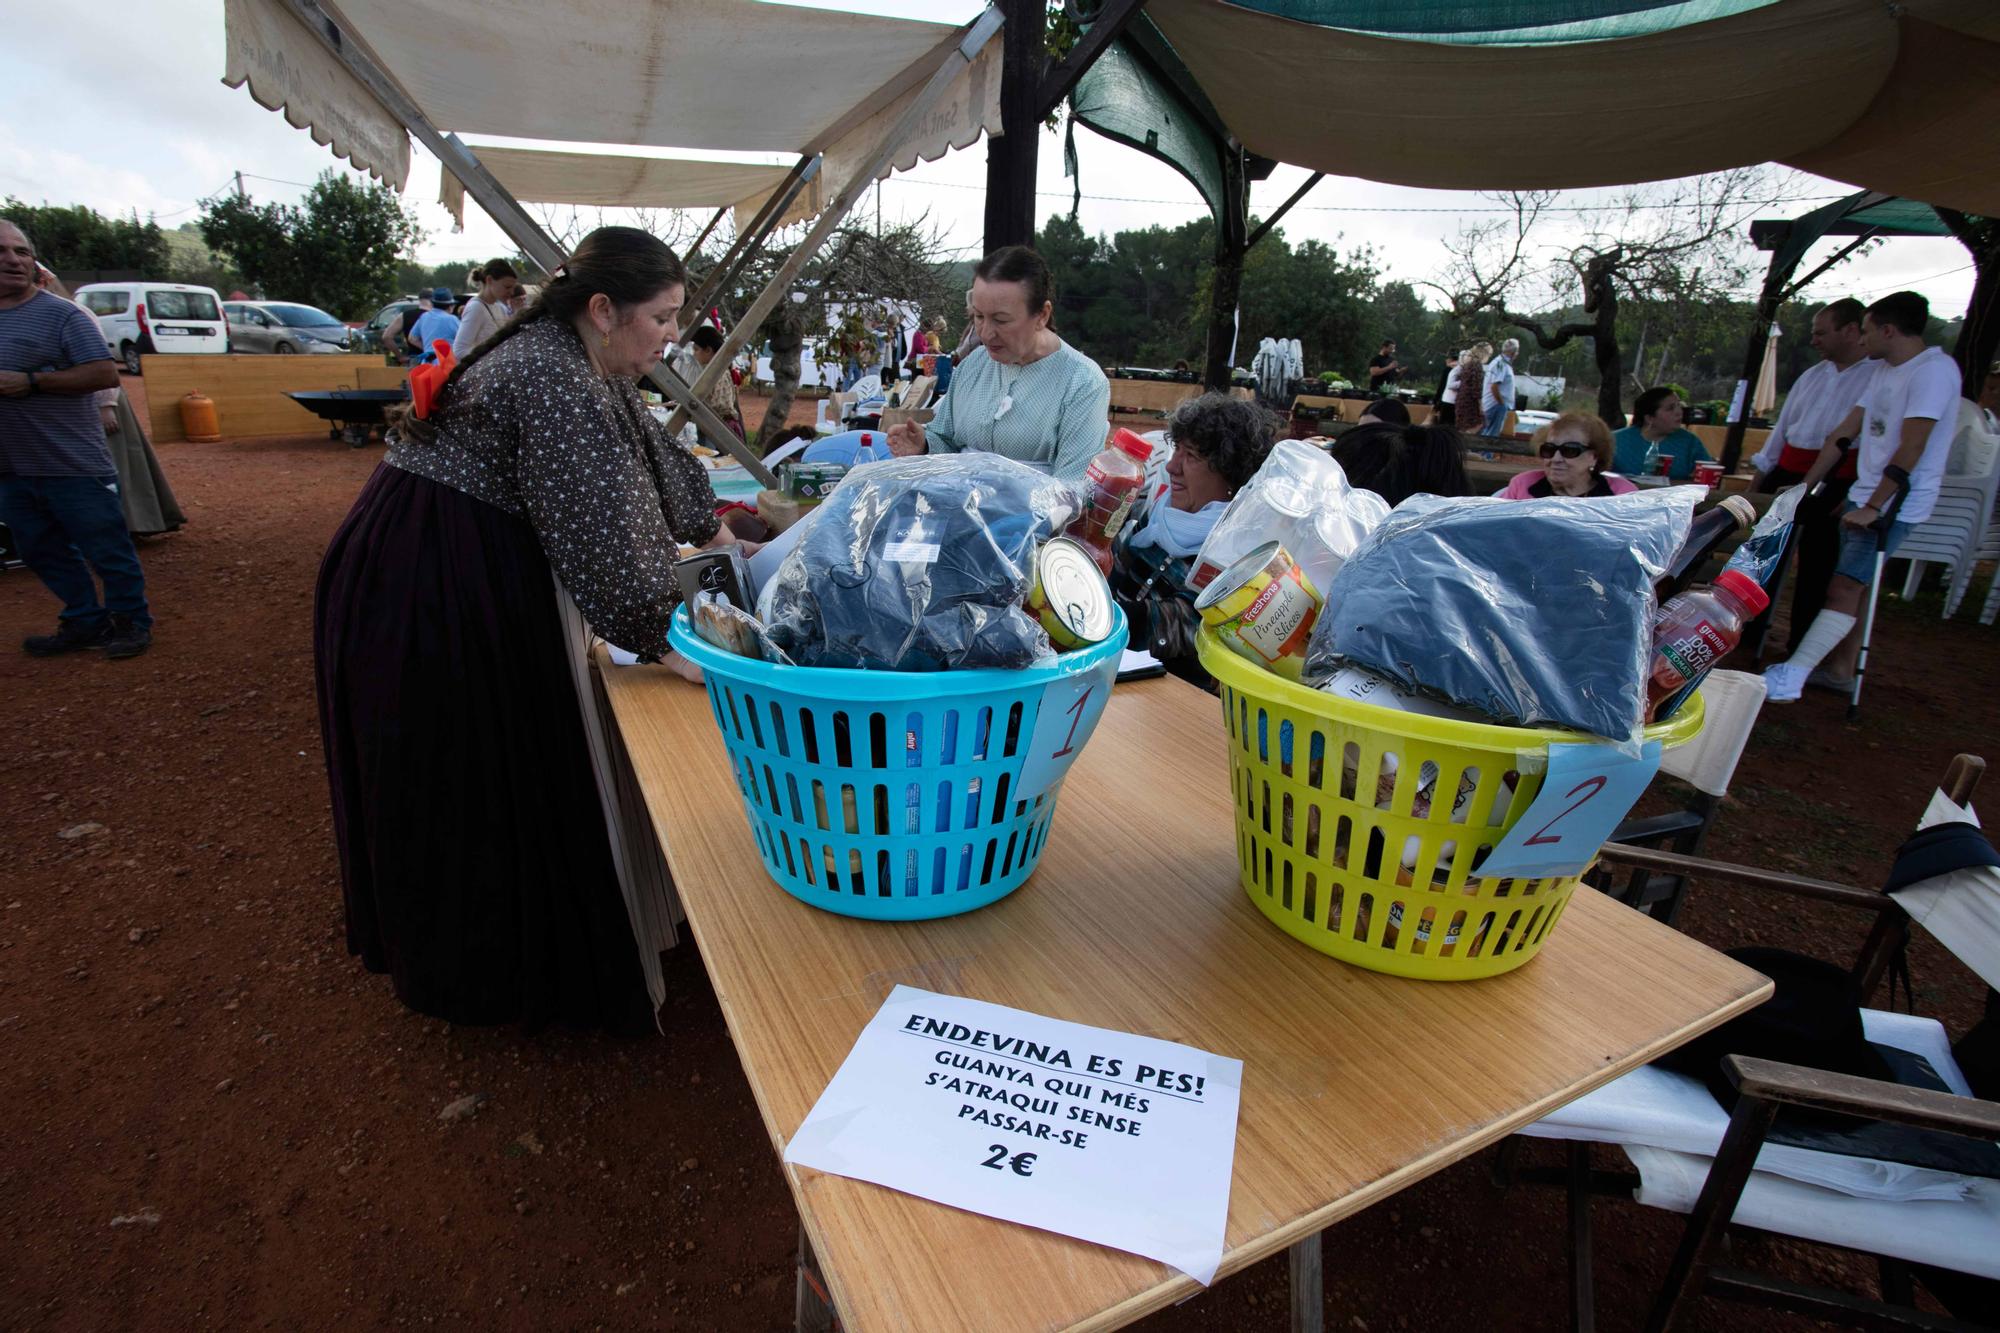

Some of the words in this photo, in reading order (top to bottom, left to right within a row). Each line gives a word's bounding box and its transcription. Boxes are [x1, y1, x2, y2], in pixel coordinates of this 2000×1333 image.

[1244, 583, 1279, 622] Freshona
[1252, 590, 1296, 640] Pineapple
[1273, 611, 1302, 641] Slices
[1698, 624, 1728, 652] granini
[1668, 650, 1693, 678] TOMATE
[1672, 638, 1707, 674] FRUTA
[1687, 634, 1714, 662] 100%
[1051, 685, 1095, 759] 1
[1522, 775, 1608, 847] 2
[905, 1014, 1073, 1069] ENDEVINA
[1087, 1054, 1123, 1078] ES
[1135, 1064, 1206, 1097] PES!
[935, 1050, 1035, 1087] GUANYA
[1044, 1078, 1092, 1100] QUI
[1101, 1088, 1150, 1114] MÉS
[925, 1072, 1059, 1116] S'ATRAQUI
[1066, 1105, 1142, 1137] SENSE
[958, 1104, 1088, 1150] PASSAR-SE
[981, 1143, 1038, 1177] 2€
